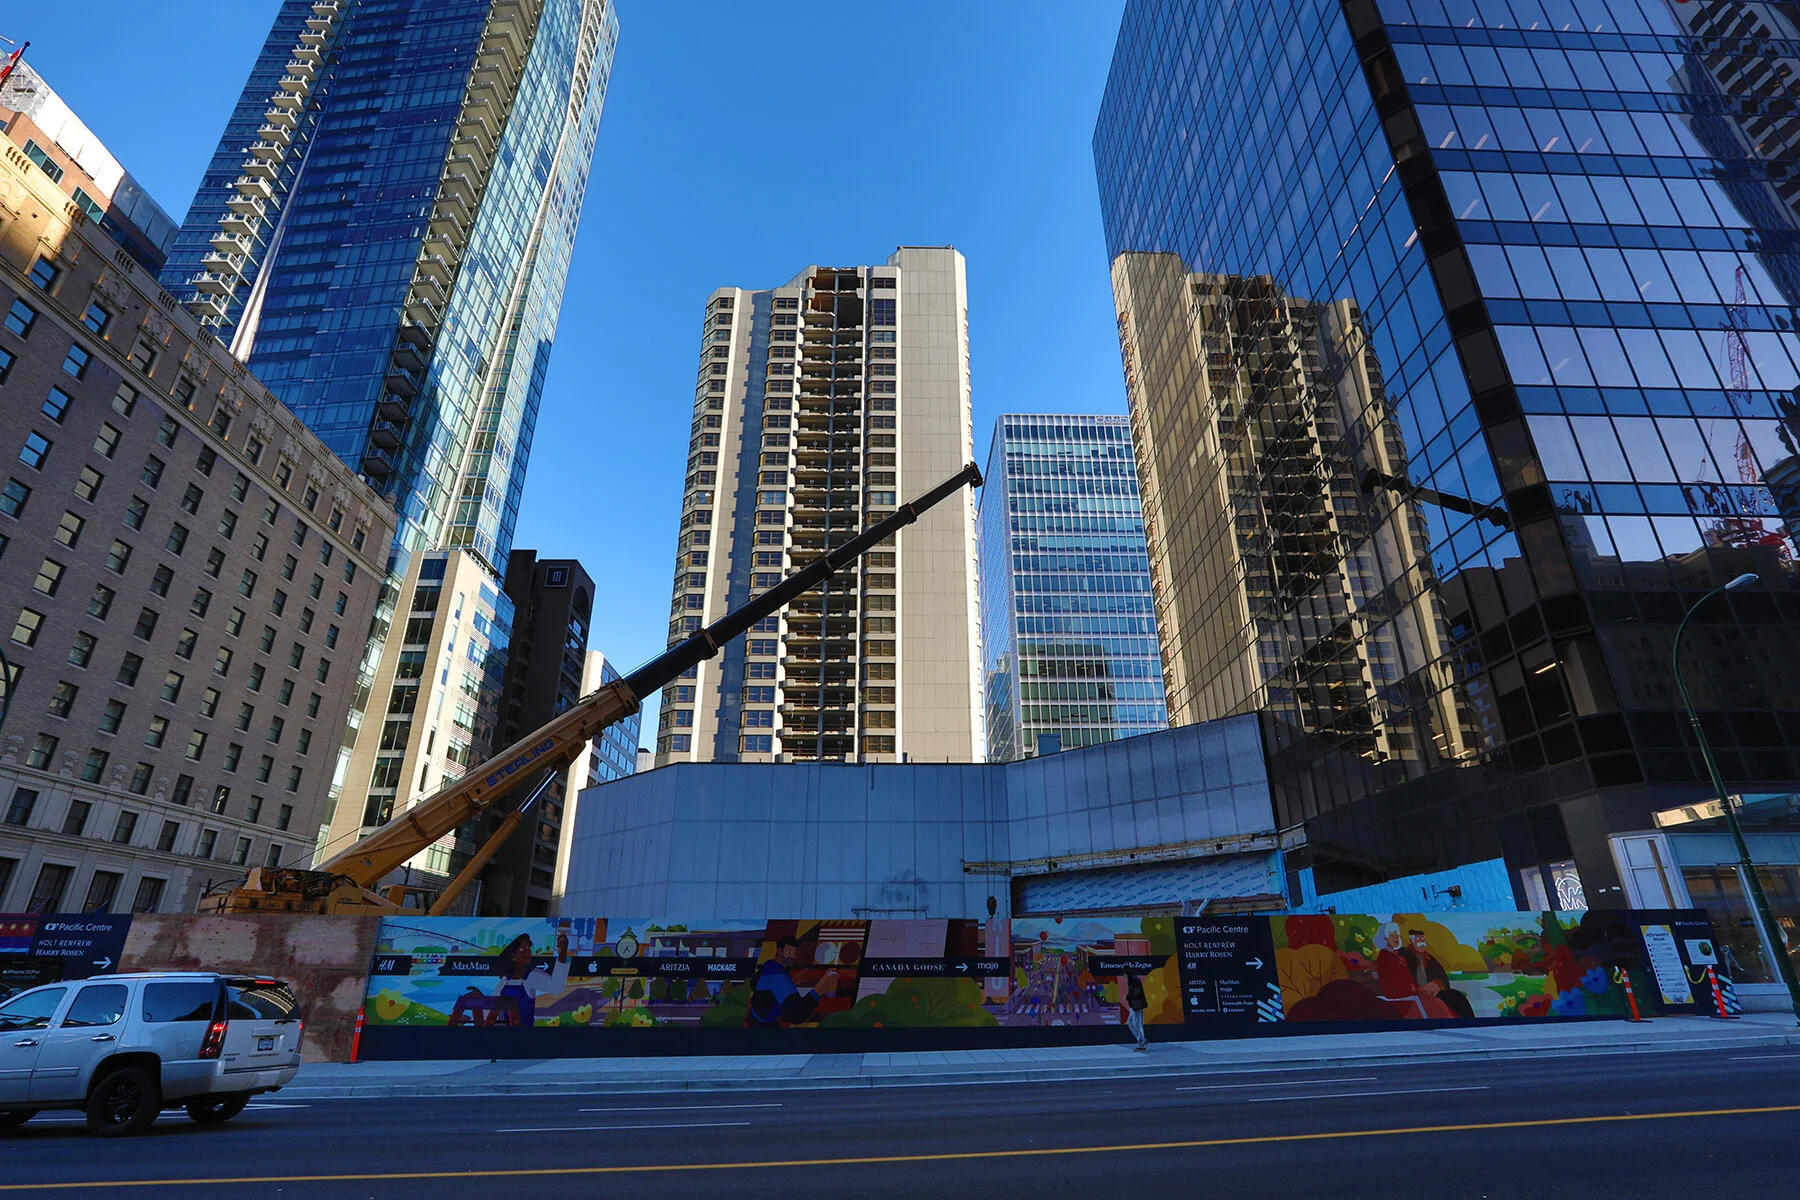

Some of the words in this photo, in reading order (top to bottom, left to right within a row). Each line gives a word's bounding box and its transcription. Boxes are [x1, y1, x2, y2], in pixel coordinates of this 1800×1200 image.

[486, 739, 555, 787] STERLING
[45, 923, 59, 931] CF
[58, 923, 84, 931] Pacific
[85, 923, 113, 931] Centre
[1183, 926, 1196, 934] CF
[1196, 926, 1222, 934] Pacific
[38, 939, 58, 947] HOLT
[58, 939, 93, 947] RENFREW
[452, 961, 490, 971] MaxMara
[659, 963, 691, 972] ARITZIA
[707, 963, 737, 972] MACKAGE
[977, 961, 999, 970] maje
